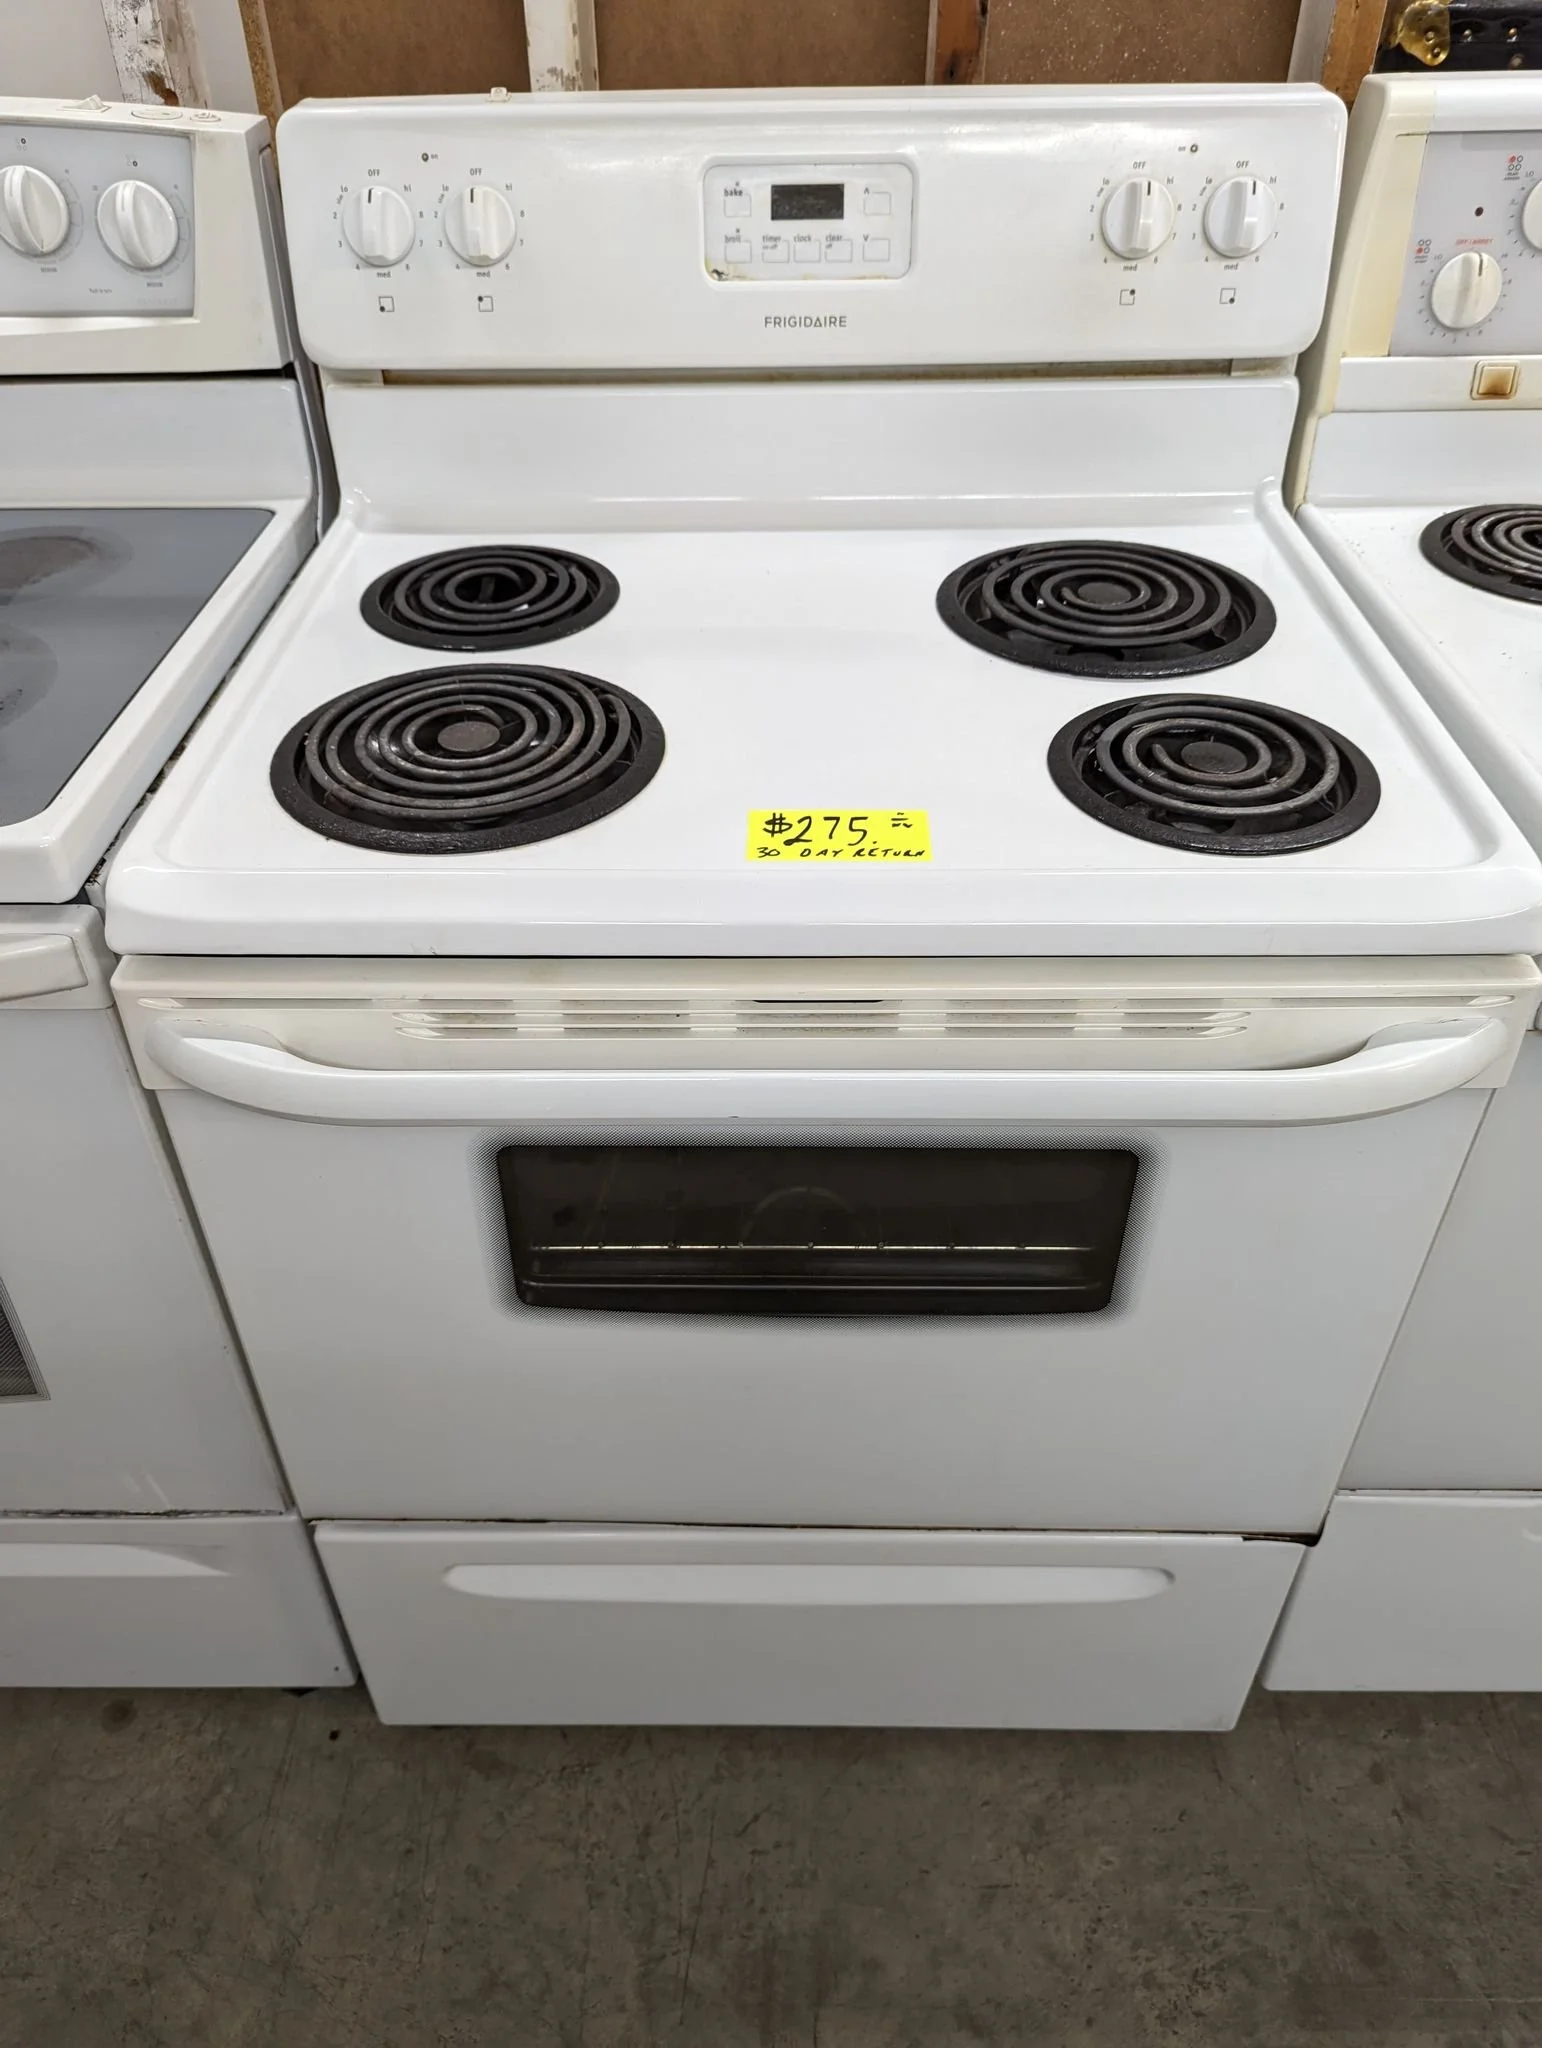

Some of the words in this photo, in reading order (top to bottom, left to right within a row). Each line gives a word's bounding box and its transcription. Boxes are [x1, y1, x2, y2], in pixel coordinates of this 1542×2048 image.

[1132, 161, 1146, 170] OFF
[1236, 160, 1250, 169] OFF
[367, 169, 381, 177] OFF
[469, 168, 483, 177] OFF
[1166, 176, 1174, 186] hi
[1269, 175, 1277, 185] hi
[340, 185, 349, 194] lo
[403, 184, 412, 193] hi
[442, 184, 450, 193] lo
[505, 183, 513, 192] hi
[723, 188, 743, 197] bake
[724, 235, 742, 244] broil
[762, 235, 782, 243] timer
[793, 234, 812, 243] clock
[825, 234, 843, 242] clear
[1122, 263, 1138, 272] med
[1223, 262, 1239, 271] med
[376, 270, 391, 279] med
[476, 270, 491, 278] med
[764, 315, 848, 328] FRIGIDAIRE
[756, 846, 781, 859] 30
[800, 848, 844, 858] DAY
[852, 847, 926, 858] RETURN
